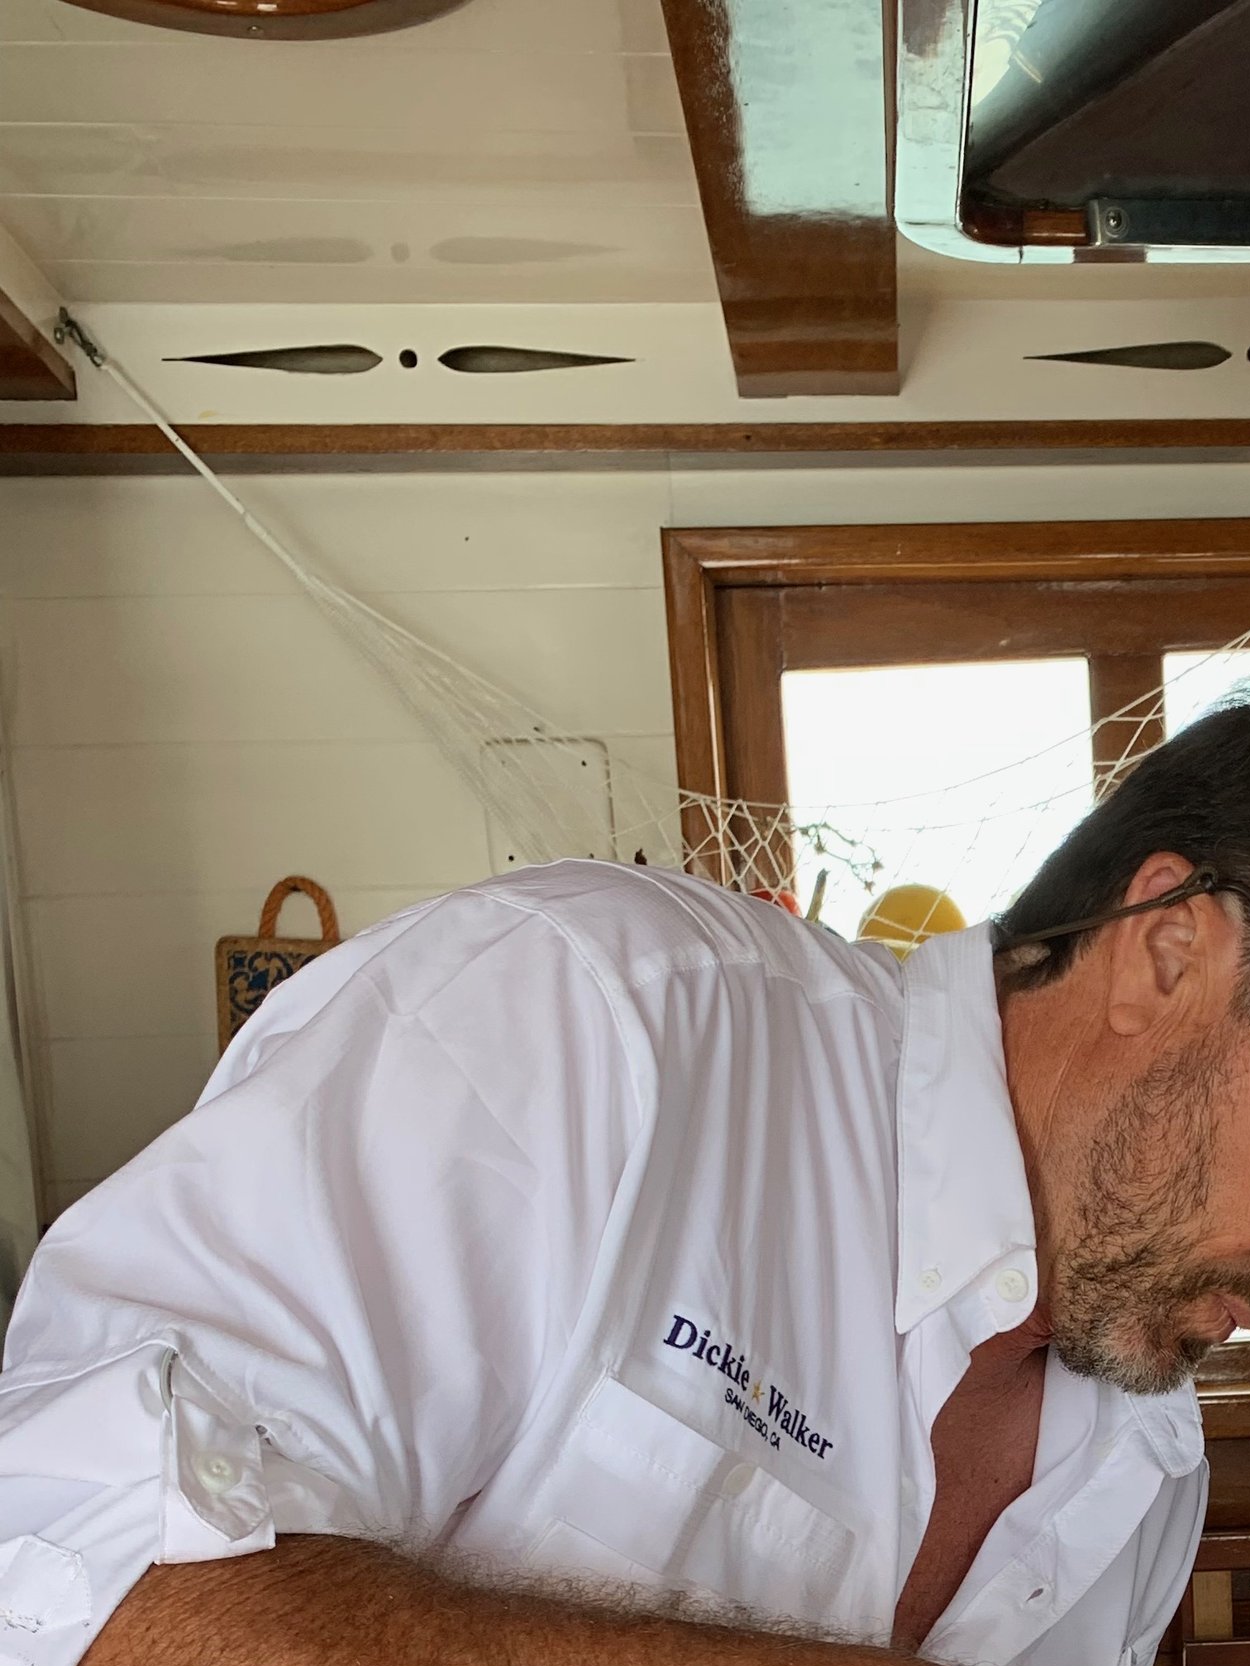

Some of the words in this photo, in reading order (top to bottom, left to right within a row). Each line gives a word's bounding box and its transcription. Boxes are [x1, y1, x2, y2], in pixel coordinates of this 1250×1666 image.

[663, 1314, 750, 1391] Dickie
[766, 1384, 834, 1460] Walker
[724, 1388, 743, 1413] SAN
[743, 1405, 769, 1443] DIEGO,
[769, 1431, 781, 1451] CA
